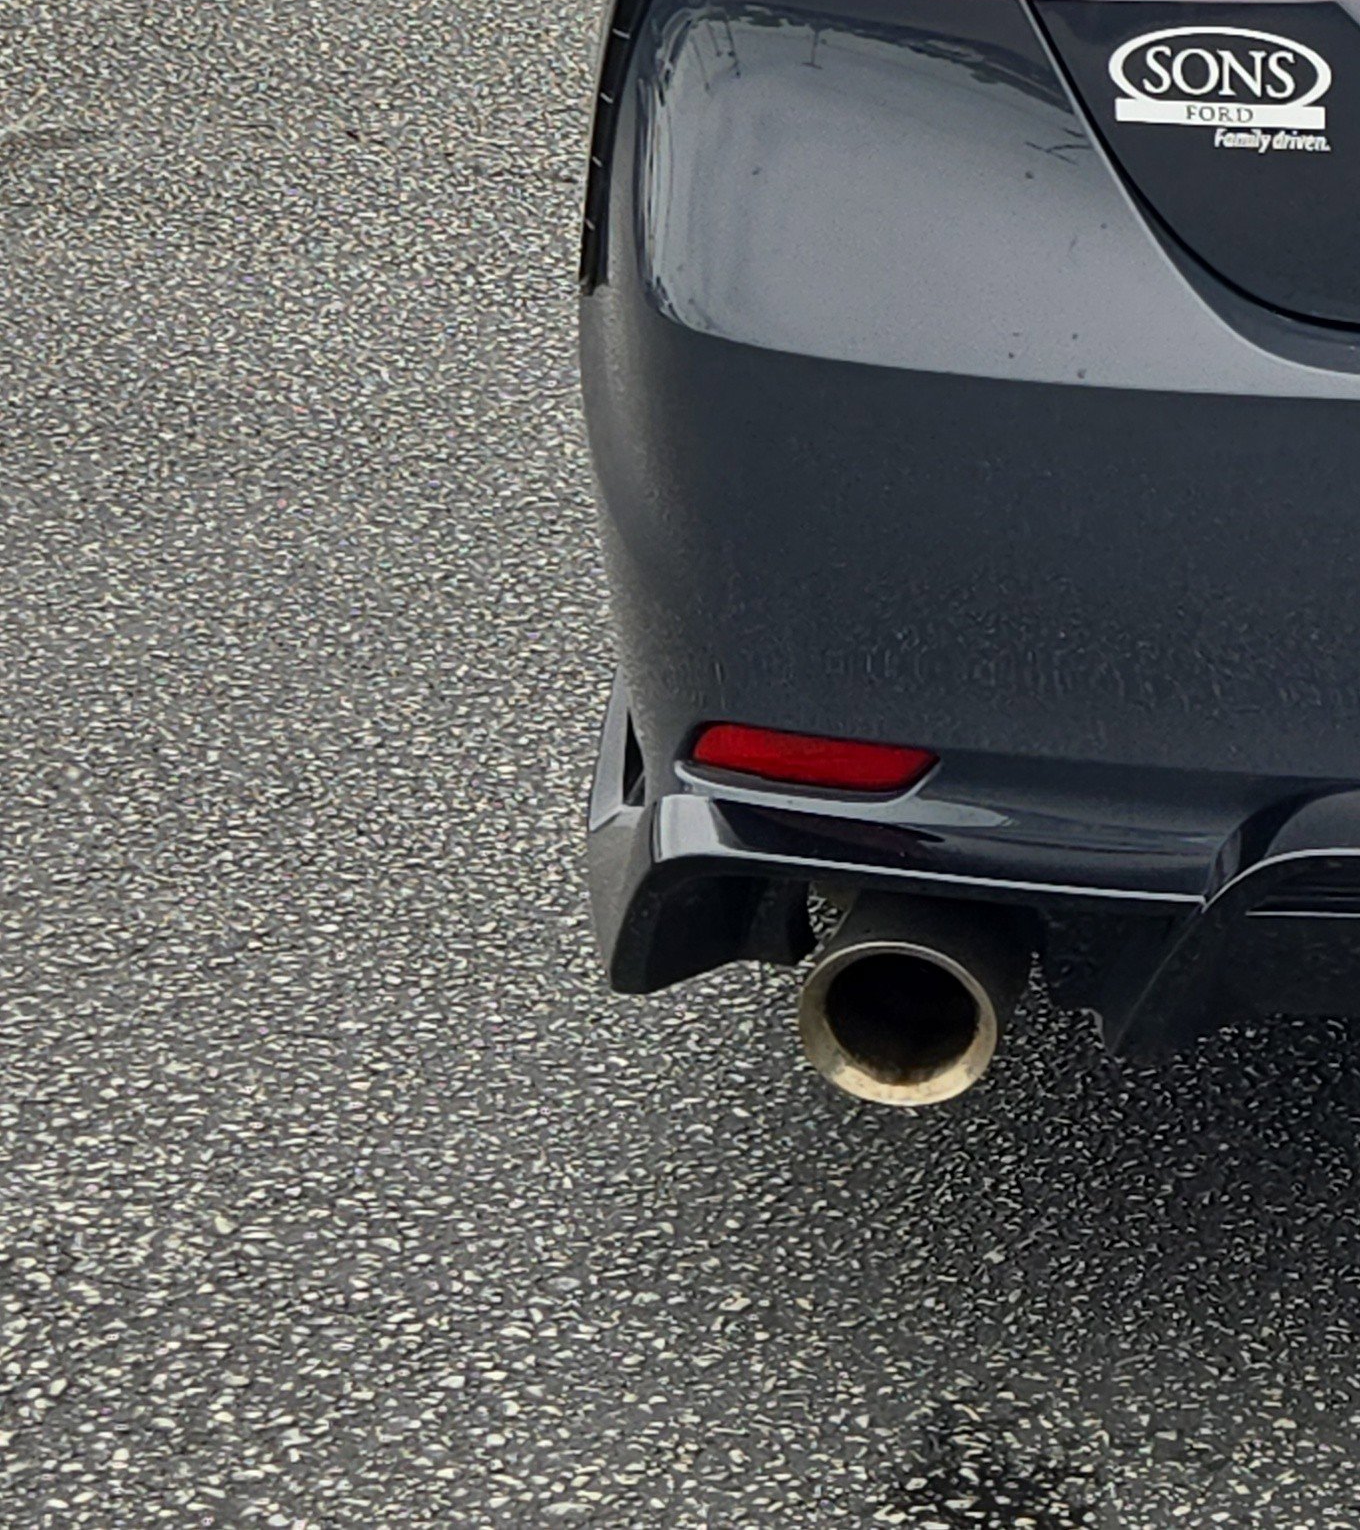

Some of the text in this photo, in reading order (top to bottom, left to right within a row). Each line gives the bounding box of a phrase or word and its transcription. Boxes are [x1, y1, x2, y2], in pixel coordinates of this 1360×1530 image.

[1142, 45, 1296, 99] SONS
[1186, 105, 1254, 123] FORD
[1214, 128, 1271, 154] Family
